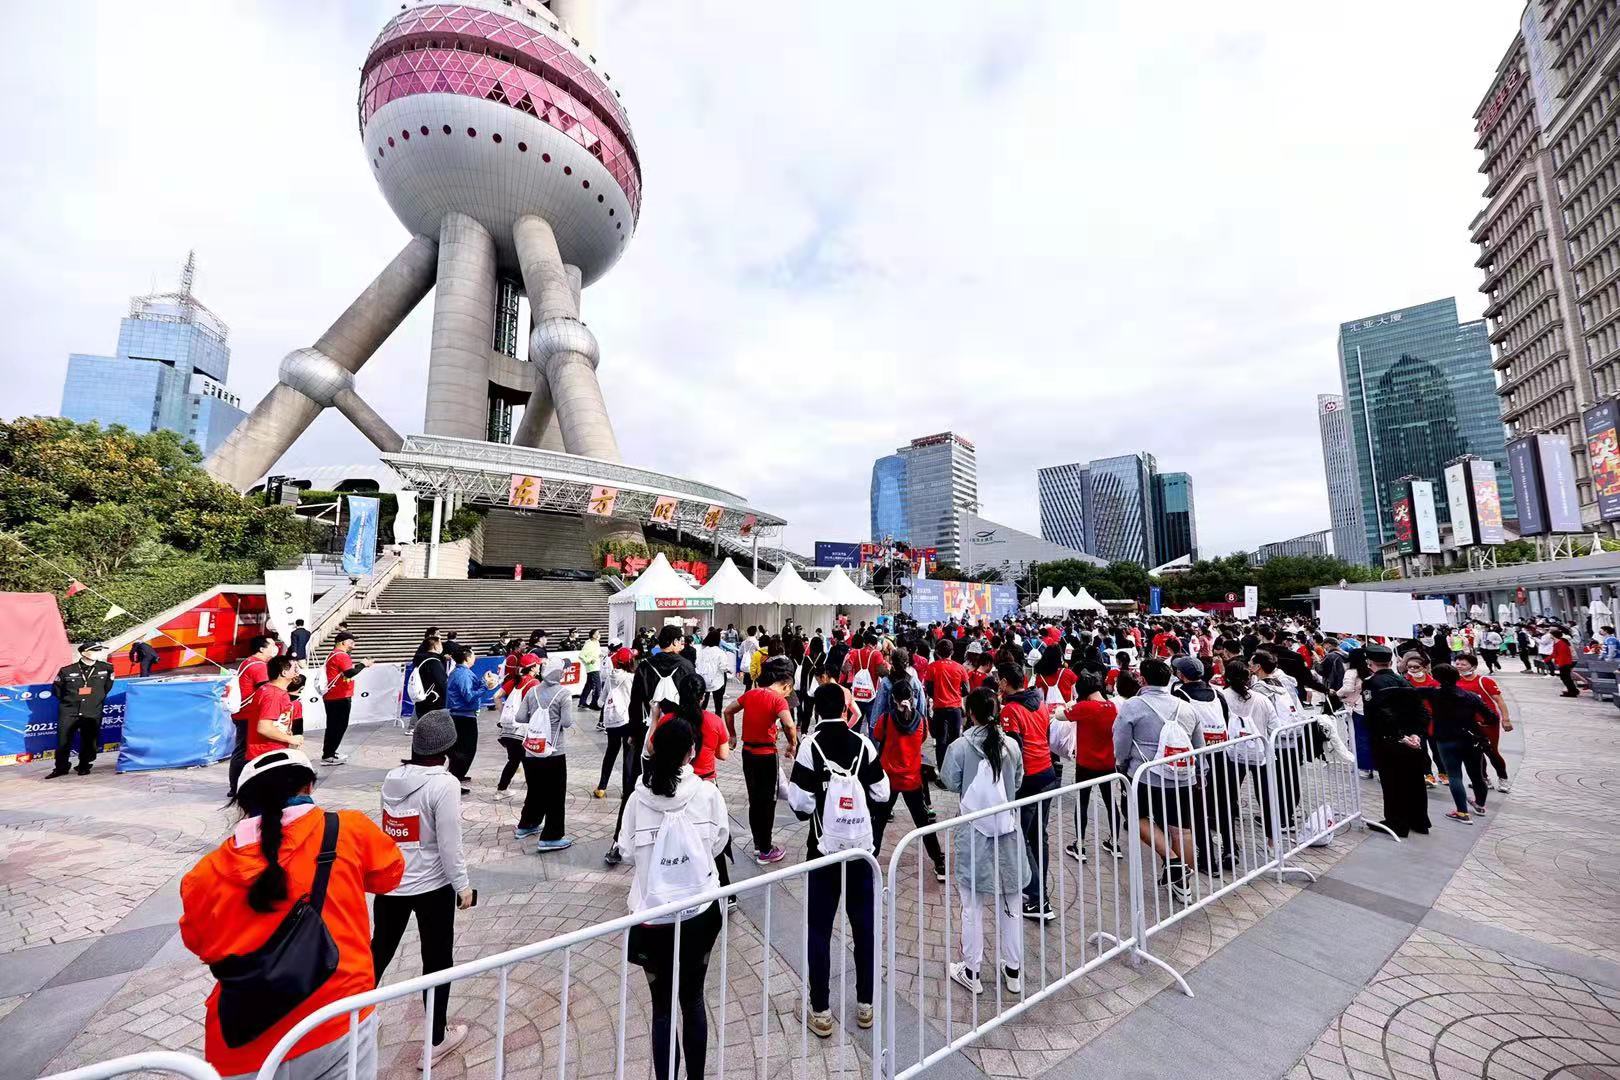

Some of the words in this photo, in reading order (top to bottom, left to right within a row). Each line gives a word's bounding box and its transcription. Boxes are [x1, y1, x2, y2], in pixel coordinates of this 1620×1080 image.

[1350, 312, 1402, 332] 汇业大厦
[24, 722, 58, 733] 2021
